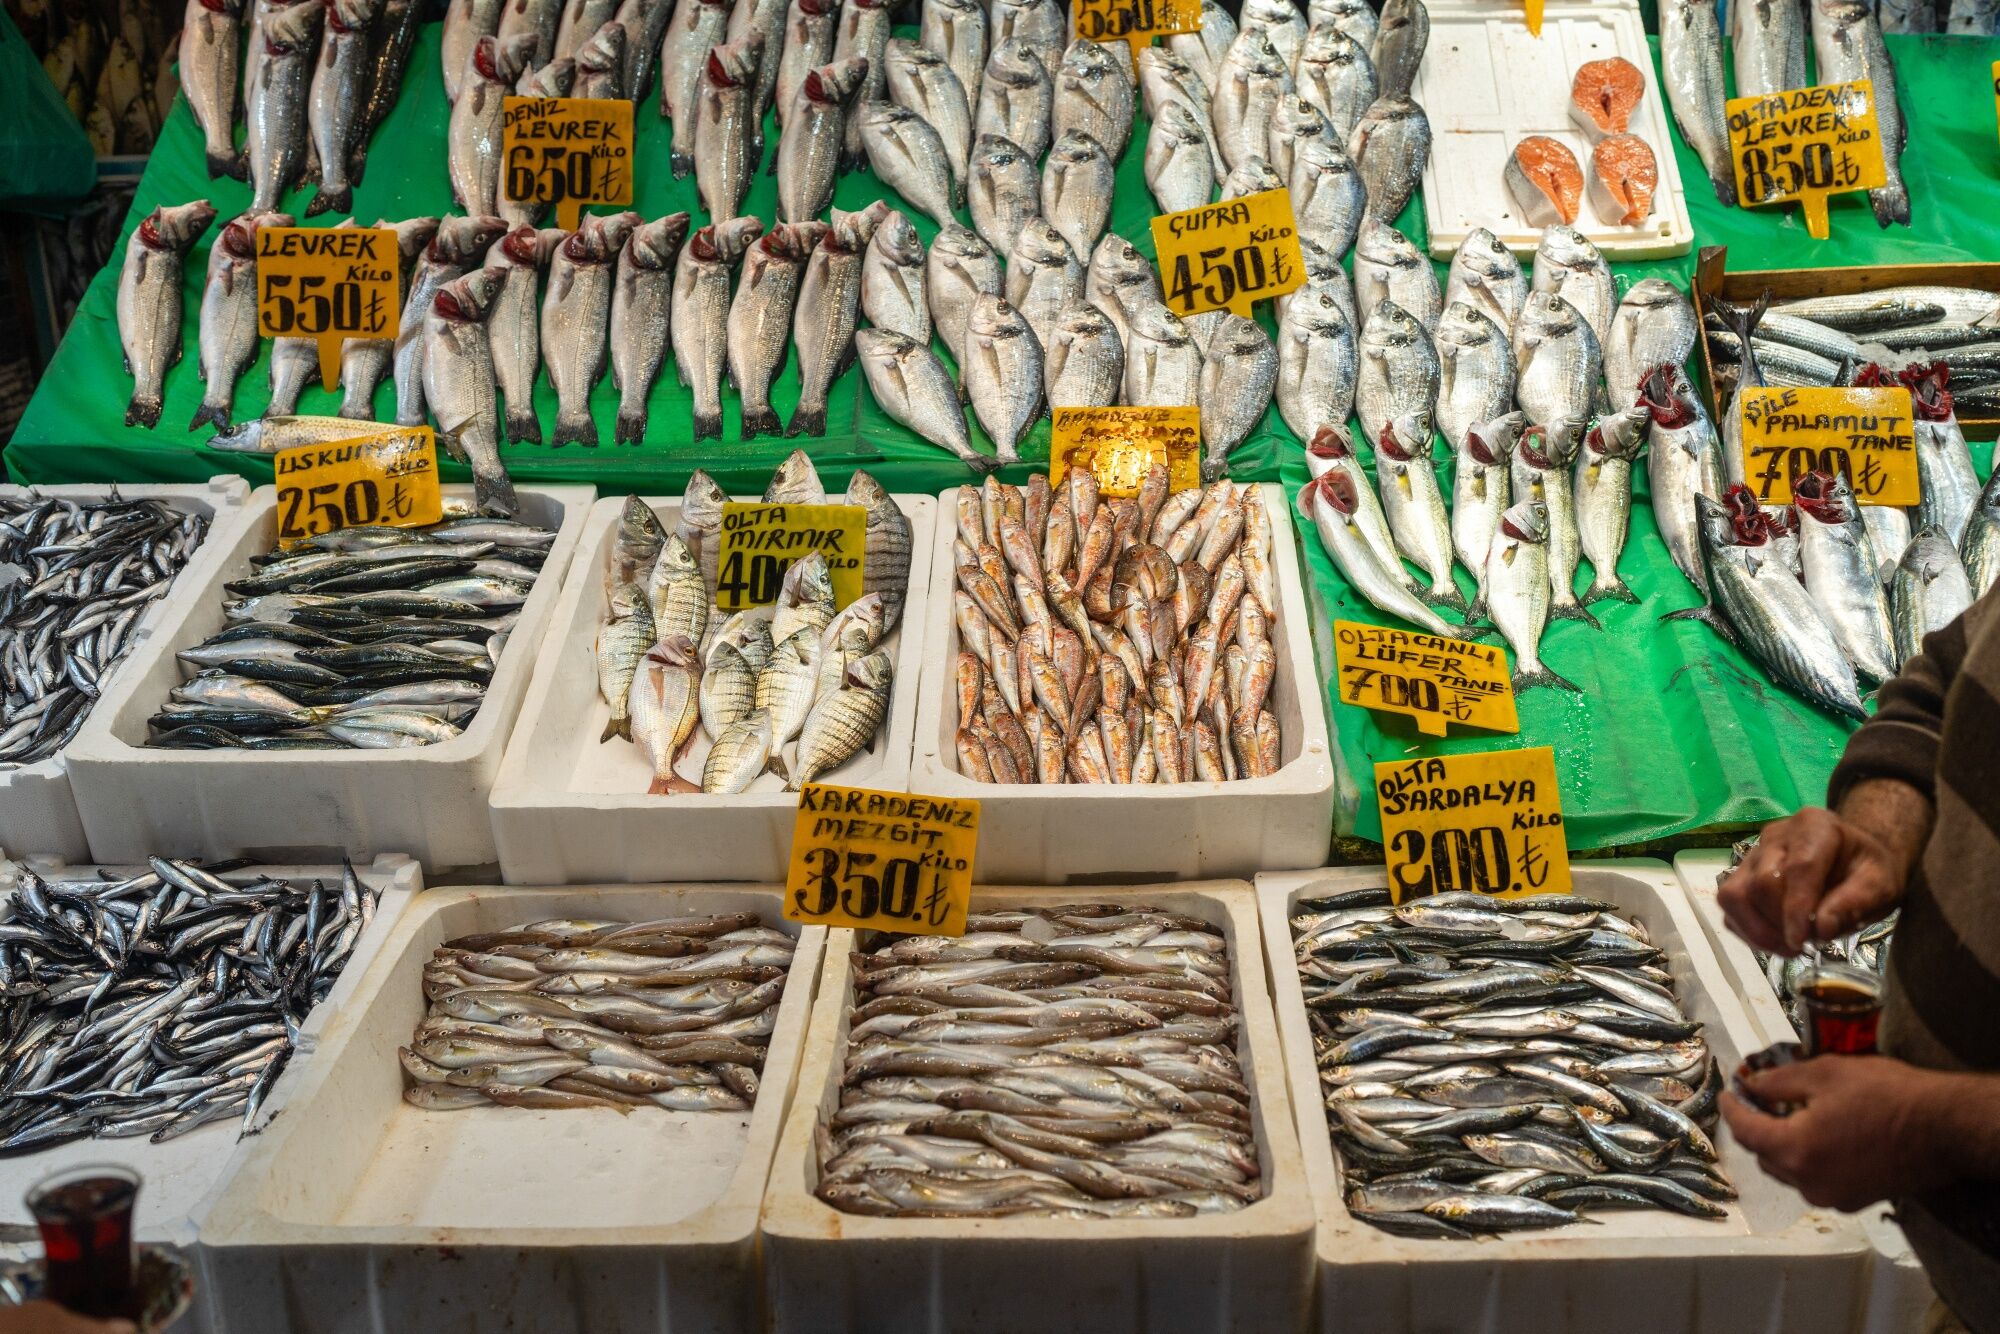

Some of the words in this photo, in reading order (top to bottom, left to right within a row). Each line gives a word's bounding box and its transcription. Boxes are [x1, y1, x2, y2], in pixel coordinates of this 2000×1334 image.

[1728, 96, 1788, 132] OLTA
[1791, 85, 1867, 112] DENİ
[514, 120, 621, 140] LEVREK
[1741, 112, 1849, 147] LEVREK
[1169, 202, 1250, 240] ÇUPRA
[259, 233, 377, 260] LEVREK
[1765, 414, 1905, 434] PALAMUT
[278, 435, 426, 475] USKUMU
[1846, 434, 1913, 451] TANE
[724, 507, 786, 531] OLTA
[728, 529, 844, 552] MIRMIR
[823, 554, 859, 569] İLO
[1339, 629, 1409, 645] OLTA
[1413, 635, 1497, 663] CANLI
[1356, 643, 1467, 676] LÜFER
[1379, 758, 1446, 799] OLTA
[1383, 779, 1535, 815] SARDALYA
